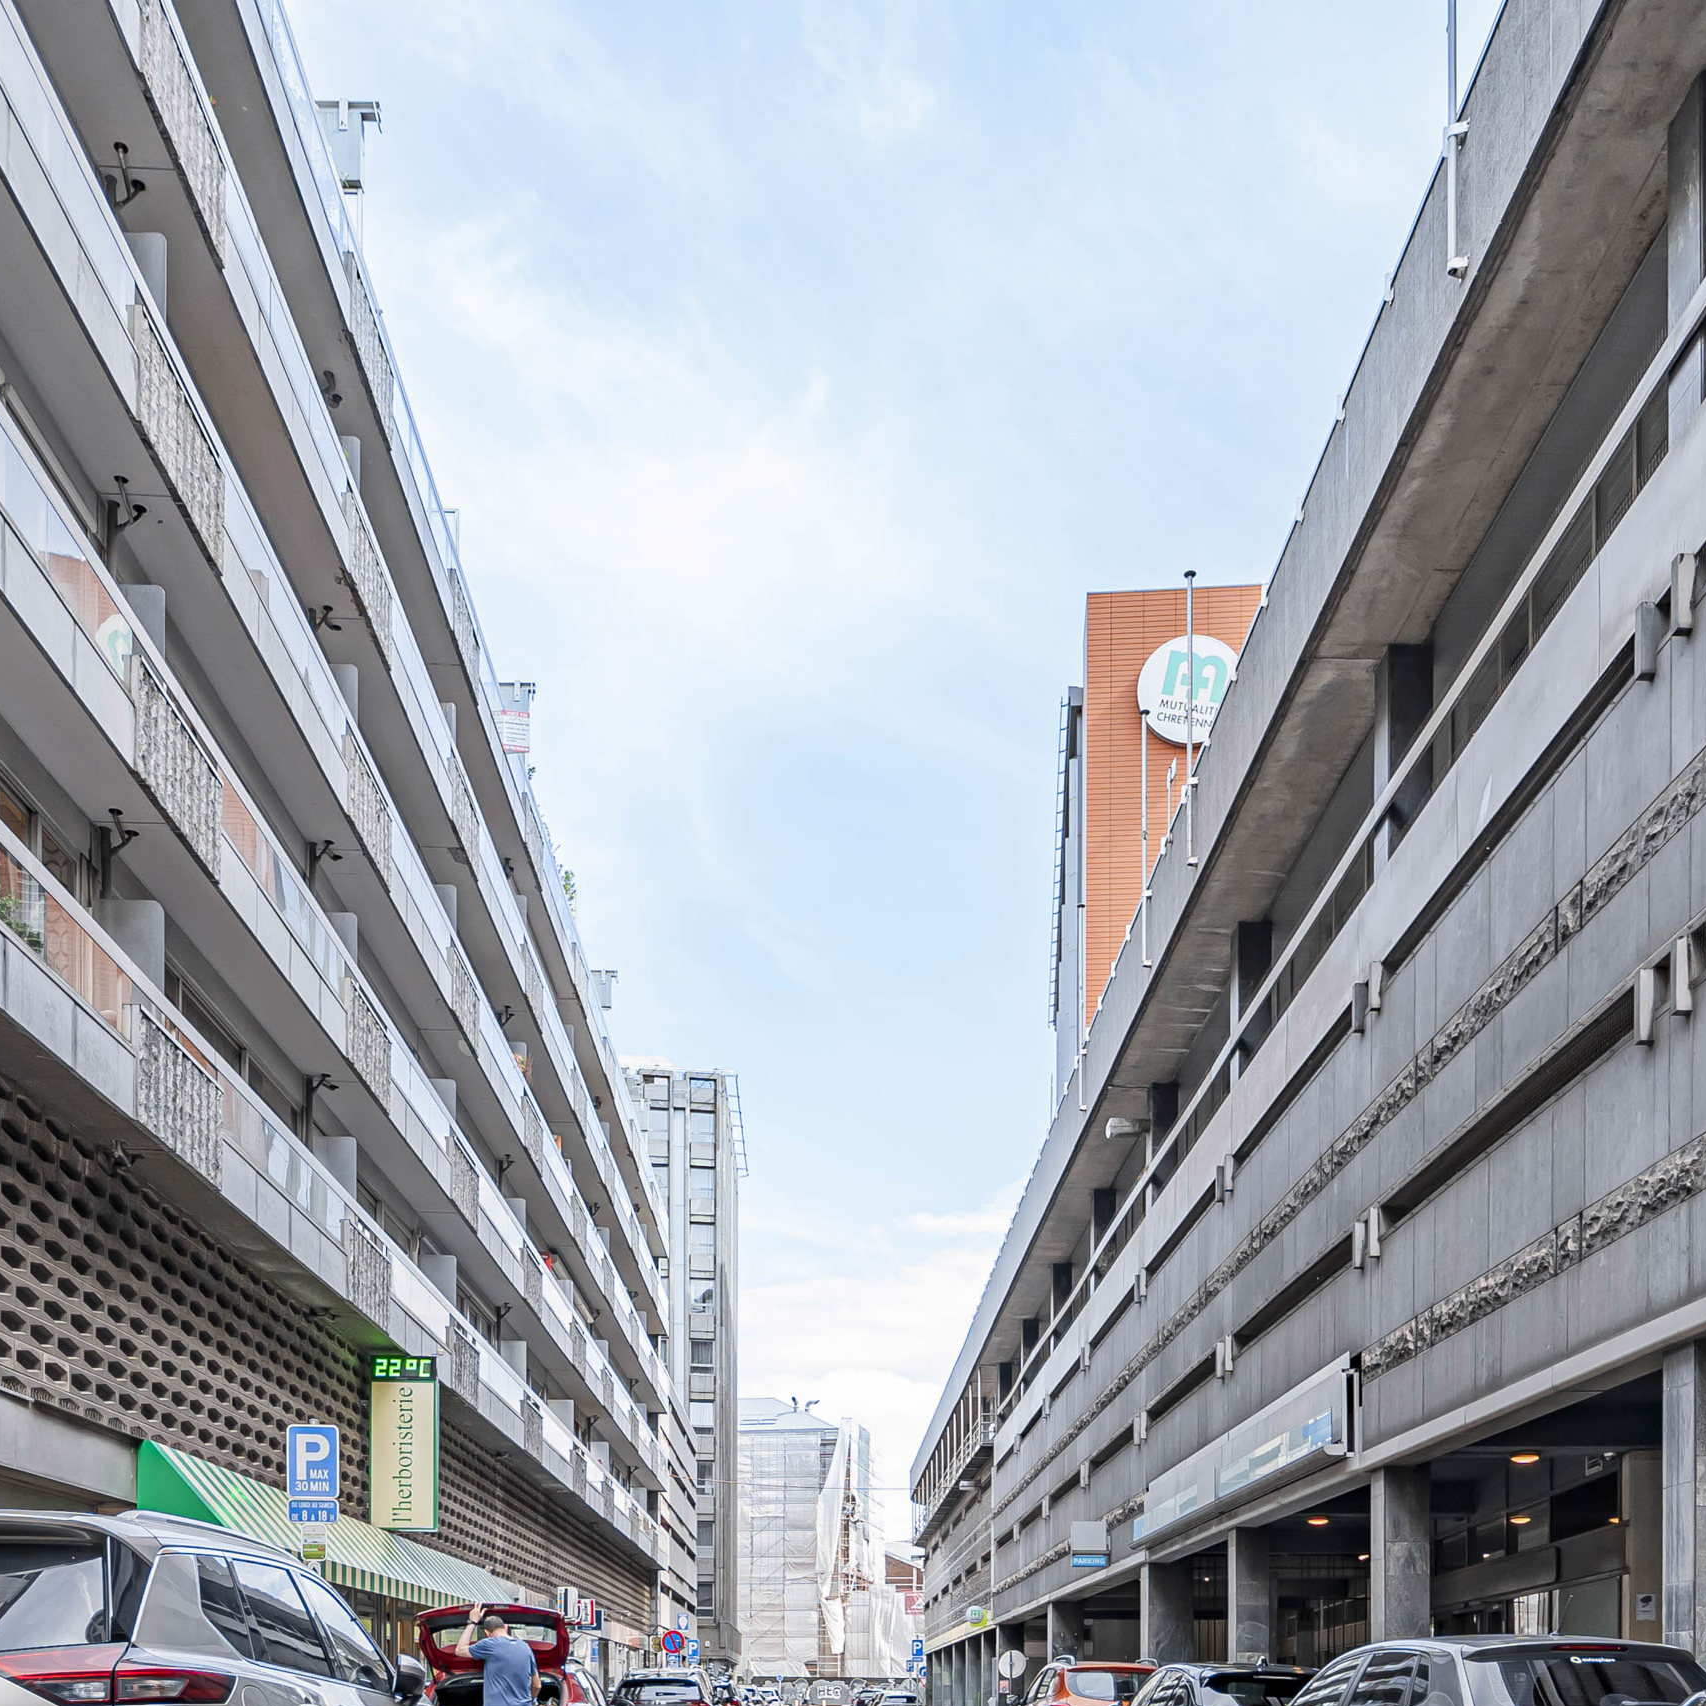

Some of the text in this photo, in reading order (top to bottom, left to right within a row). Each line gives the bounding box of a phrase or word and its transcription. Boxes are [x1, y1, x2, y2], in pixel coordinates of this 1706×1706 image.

[1159, 699, 1218, 716] MUTUALIT
[1157, 712, 1213, 728] CHRETENN
[375, 1358, 431, 1378] 22°C
[296, 1434, 330, 1480] P
[392, 1387, 413, 1522] l'herboristerie
[310, 1469, 329, 1480] MAX
[295, 1481, 329, 1492] 30 MIN
[302, 1510, 308, 1521] 8
[318, 1510, 327, 1521] 18
[1073, 1557, 1106, 1565] PARKING
[688, 1642, 698, 1656] P
[913, 1641, 922, 1655] P
